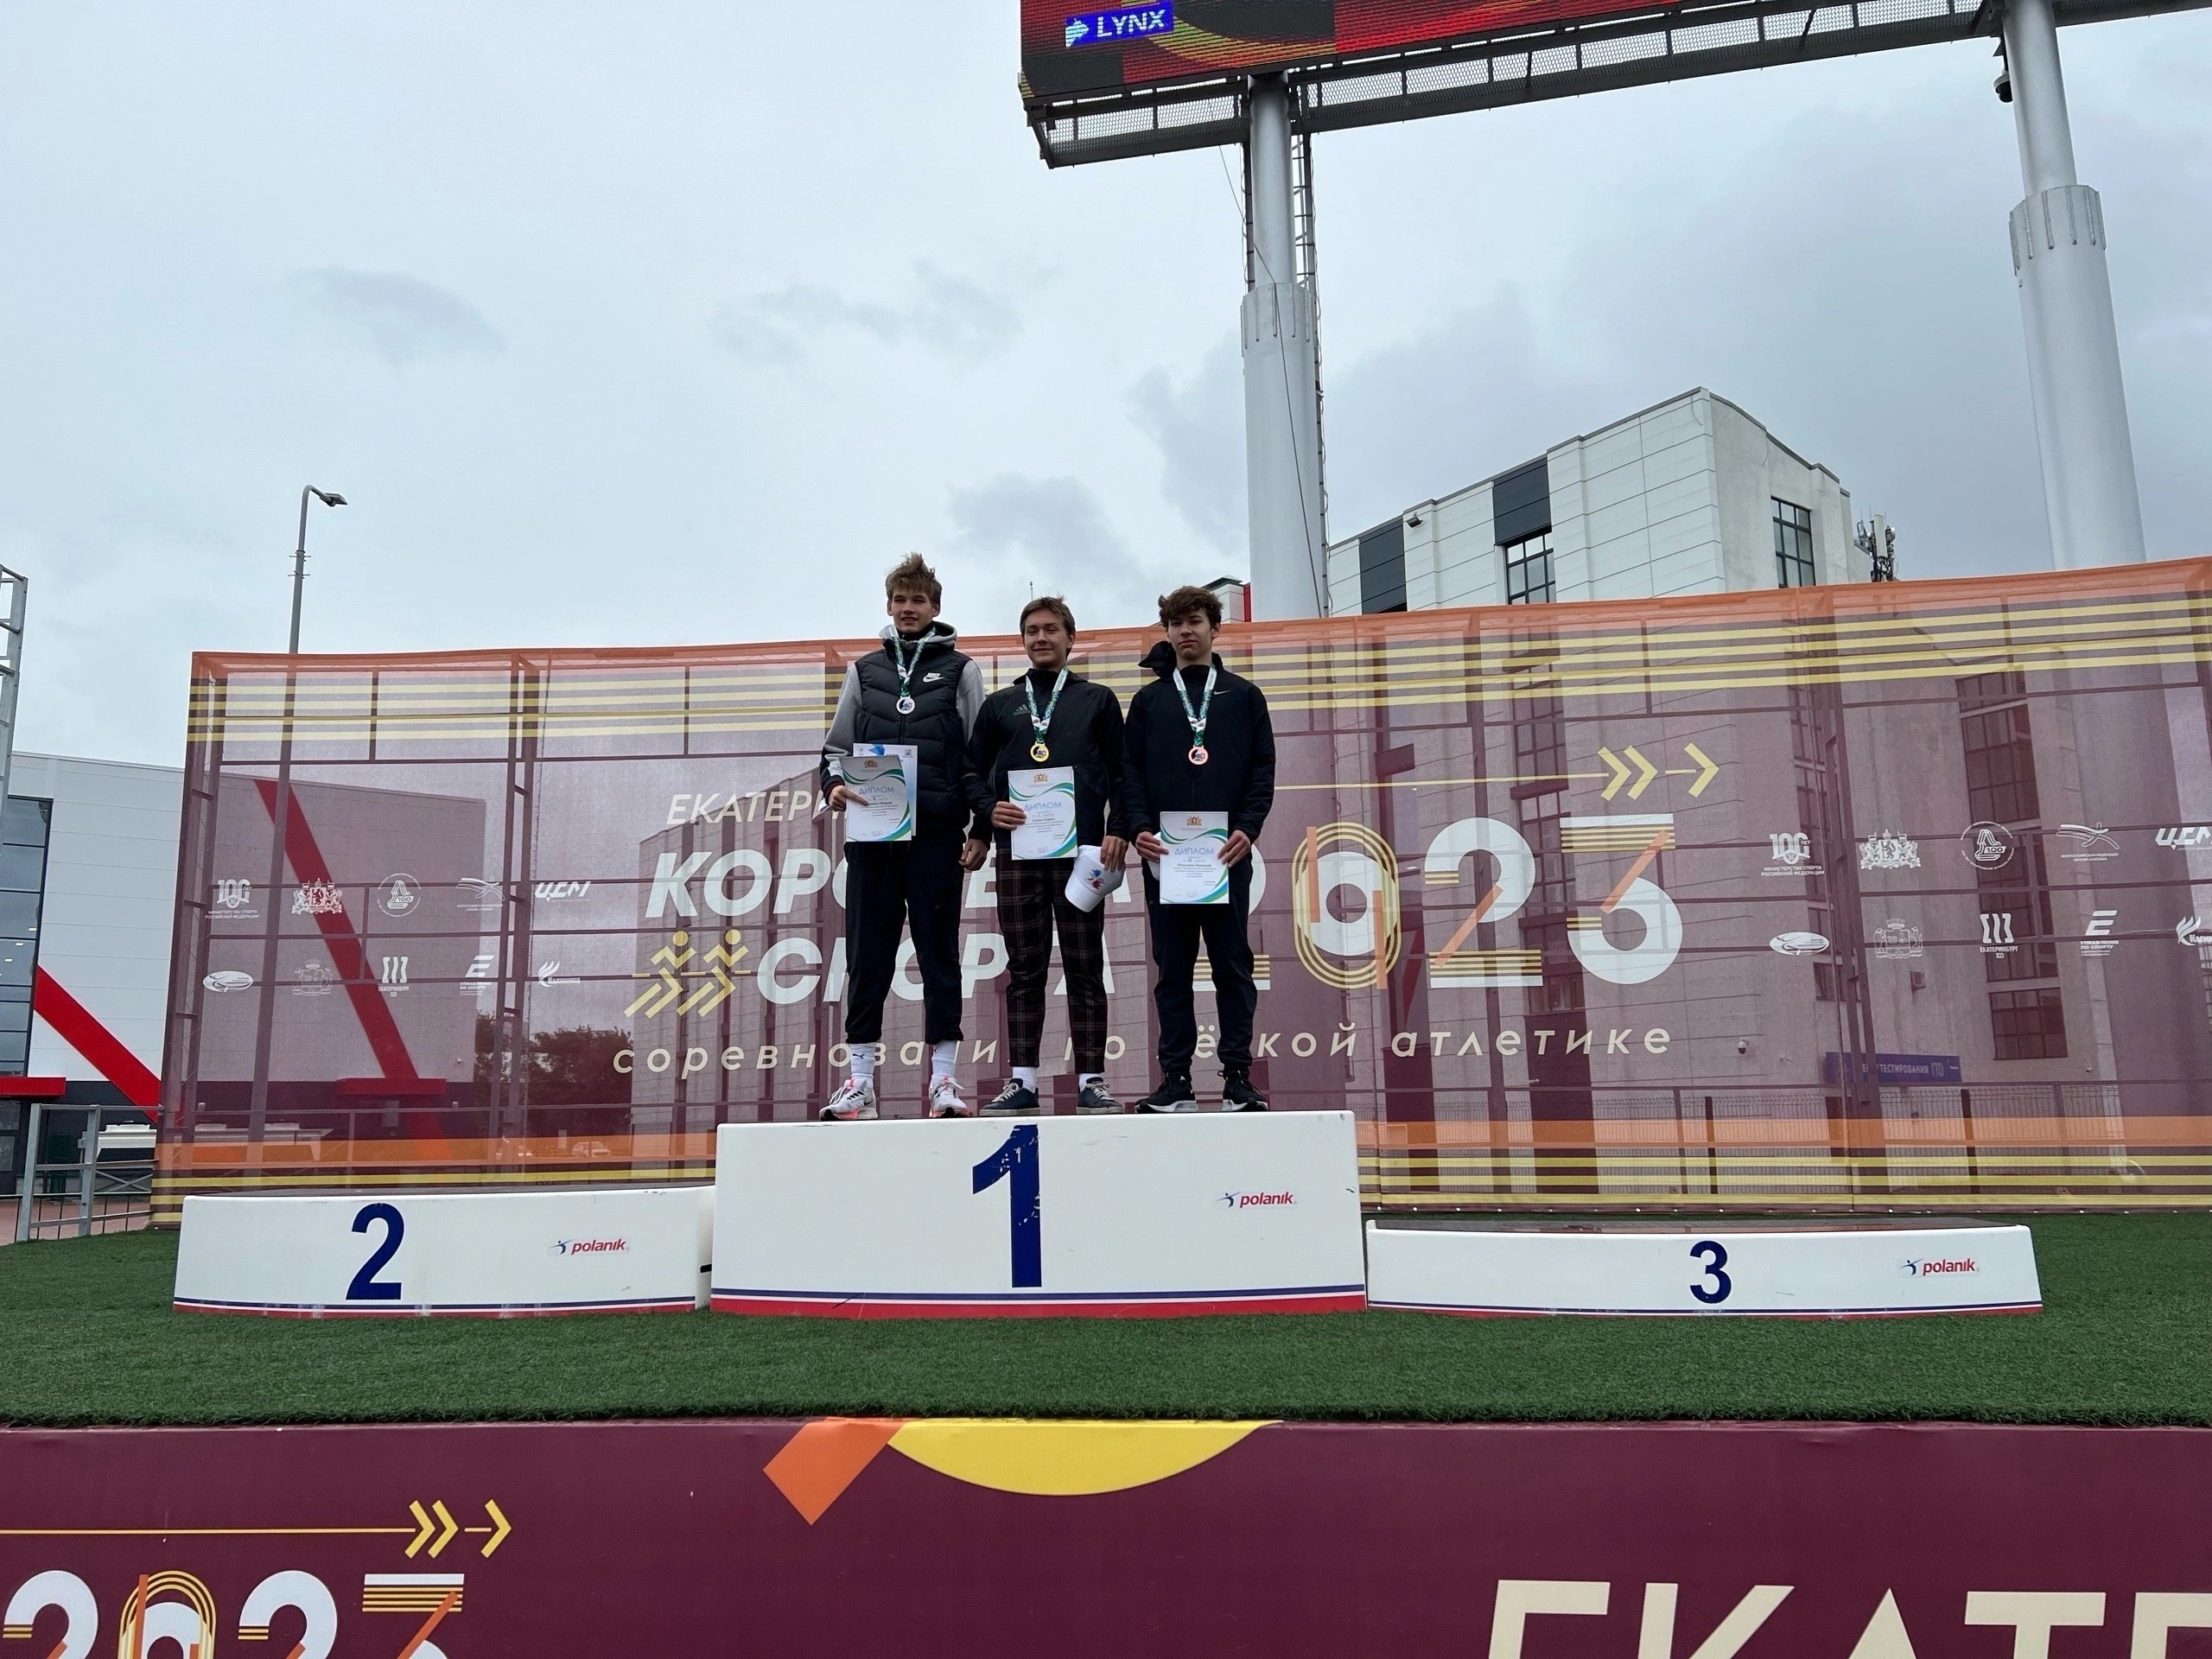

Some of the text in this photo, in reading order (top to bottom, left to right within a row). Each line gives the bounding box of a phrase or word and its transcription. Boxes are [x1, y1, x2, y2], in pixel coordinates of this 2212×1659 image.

[1096, 9, 1166, 37] LYNX
[858, 785, 895, 796] ДИПЛОМ
[1024, 801, 1062, 811] ДИПЛОМ
[1174, 847, 1214, 855] ДИПЛОМ
[1391, 1027, 1671, 1058] атлетике
[1879, 1064, 1929, 1074] ТЕСТИРОВАНИЯ
[973, 1123, 1042, 1287] 1
[346, 1202, 404, 1300] 2
[1689, 1240, 1732, 1305] 3
